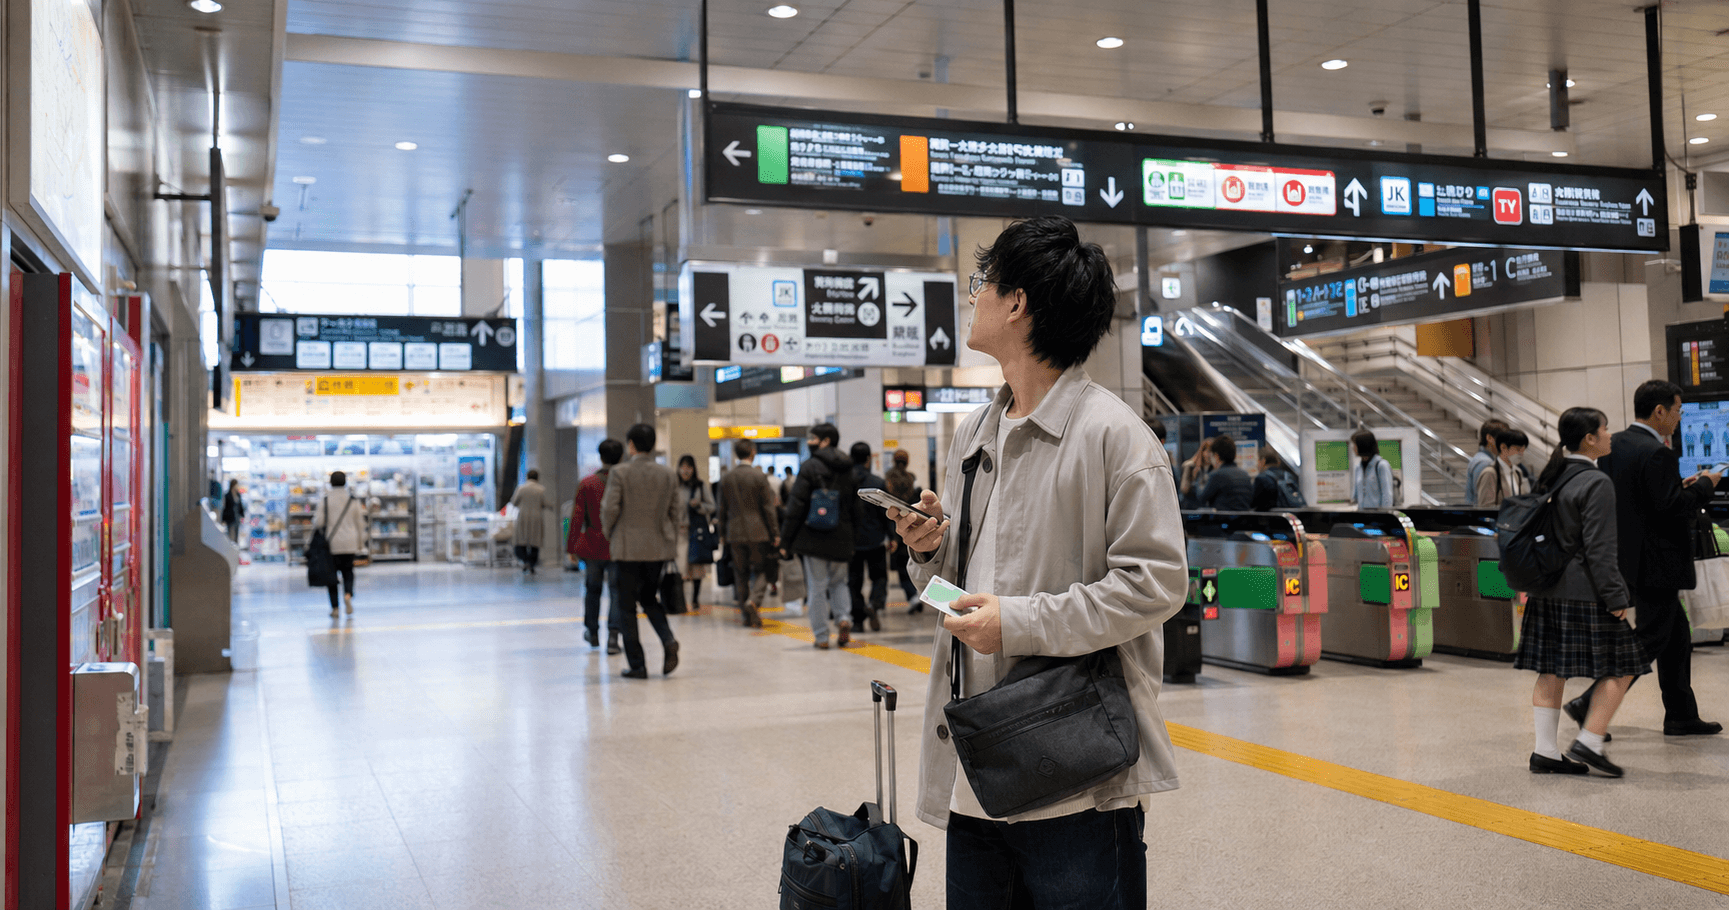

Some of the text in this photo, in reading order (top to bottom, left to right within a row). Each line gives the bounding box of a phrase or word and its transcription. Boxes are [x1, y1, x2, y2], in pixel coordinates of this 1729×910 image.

[1387, 186, 1405, 202] JK
[1498, 198, 1517, 214] TY
[1285, 578, 1300, 594] IC
[1395, 574, 1408, 590] IC
